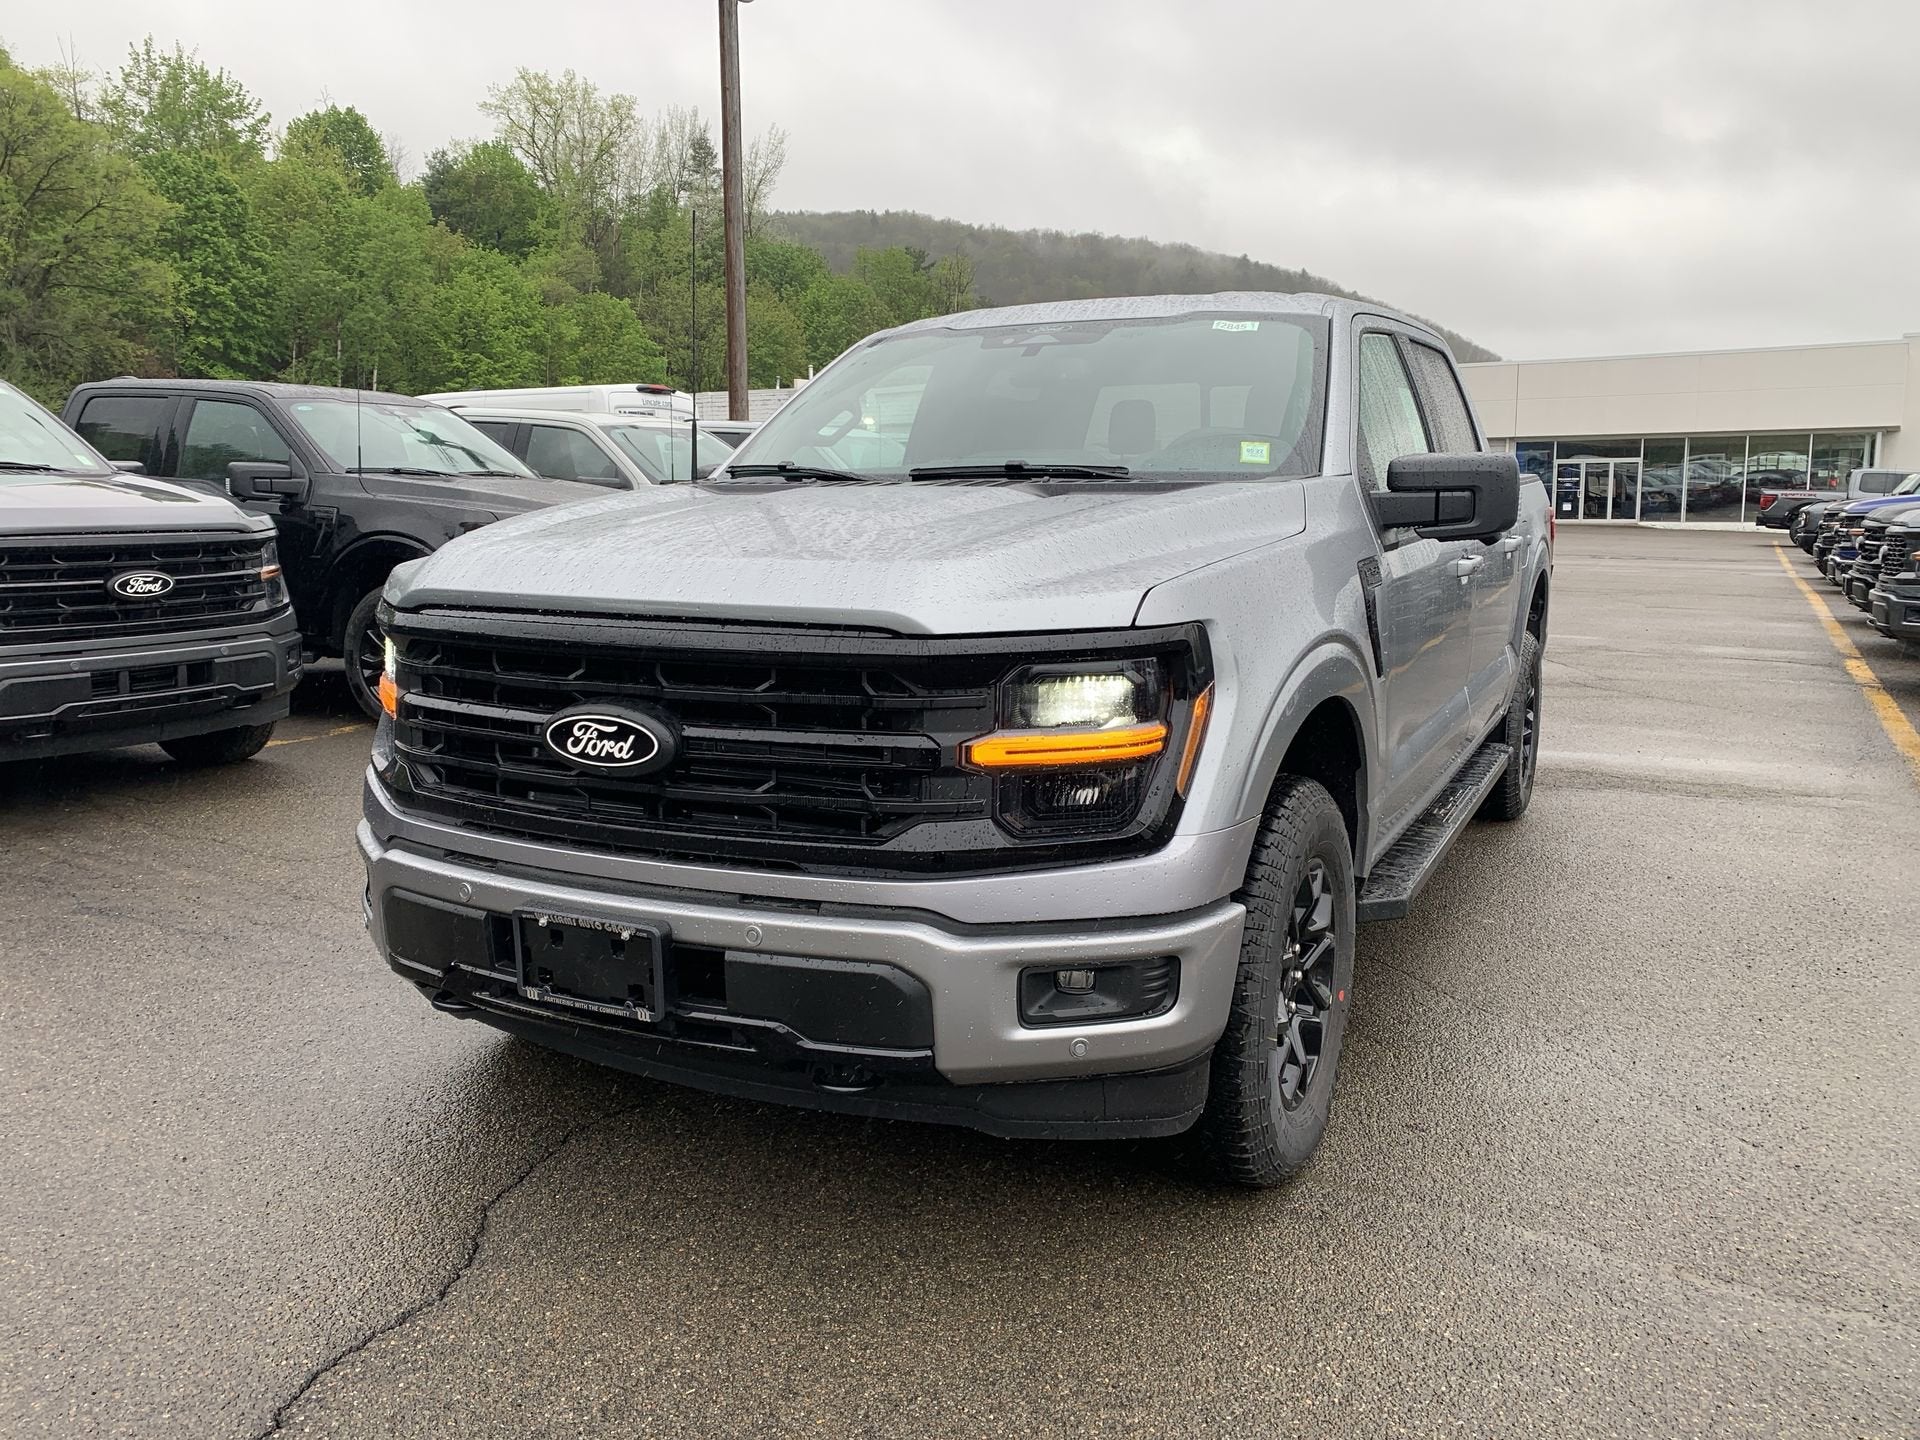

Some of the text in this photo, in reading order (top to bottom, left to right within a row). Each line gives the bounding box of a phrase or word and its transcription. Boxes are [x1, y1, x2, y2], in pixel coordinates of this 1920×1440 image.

[126, 577, 163, 593] Ford
[566, 721, 635, 760] Ford
[578, 920, 603, 930] AUTO
[574, 1001, 589, 1010] WITH
[588, 1004, 600, 1012] THE
